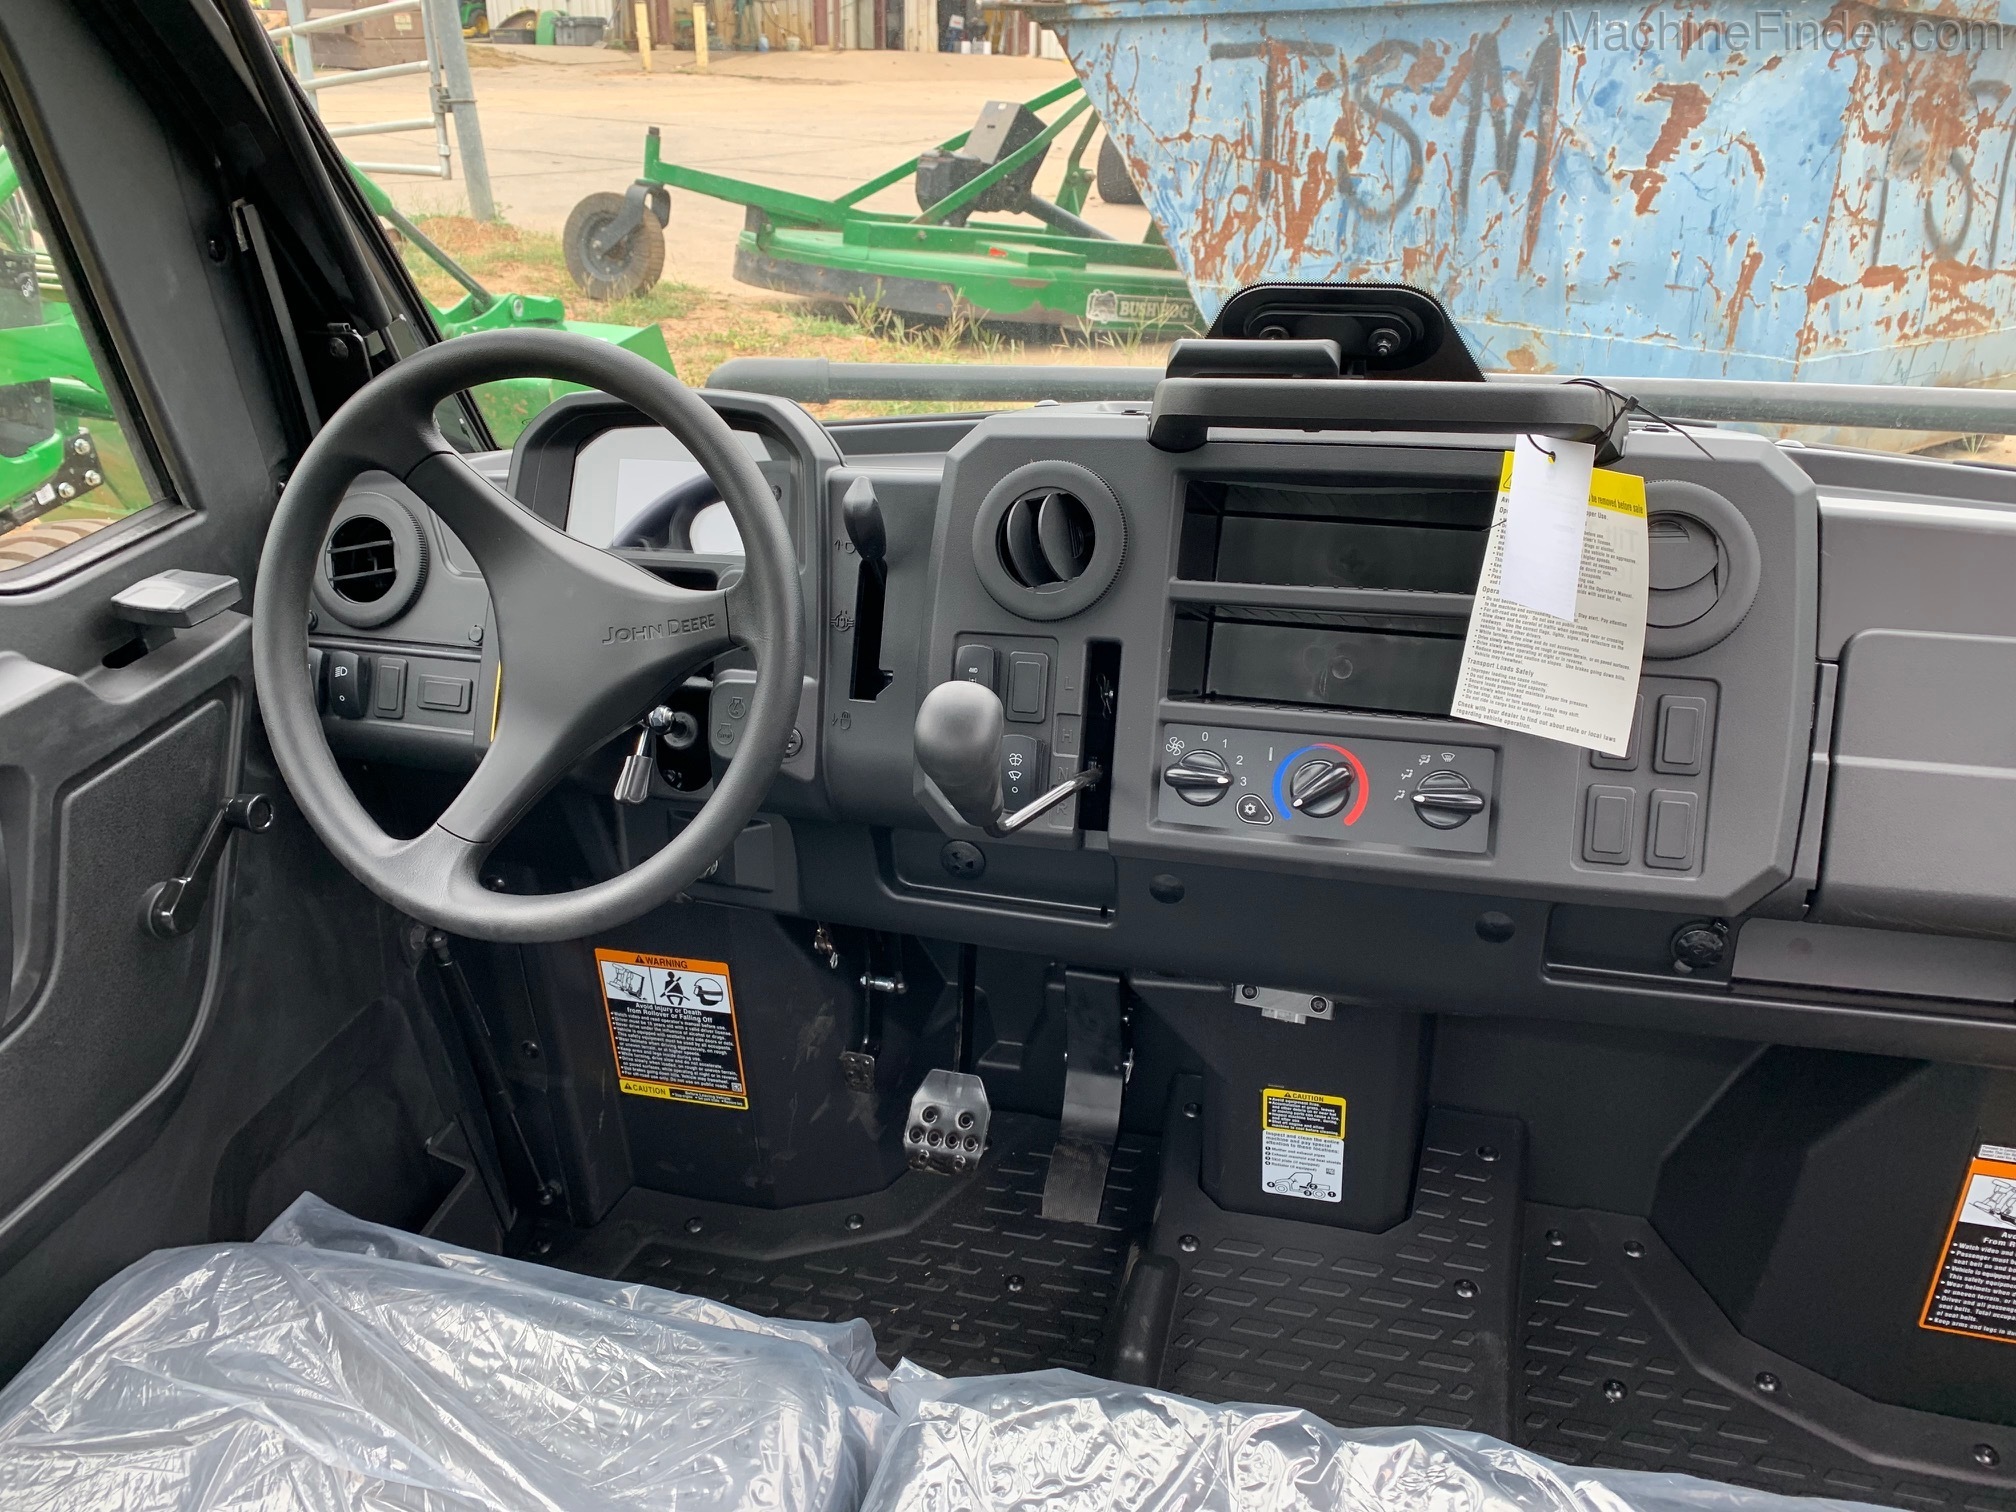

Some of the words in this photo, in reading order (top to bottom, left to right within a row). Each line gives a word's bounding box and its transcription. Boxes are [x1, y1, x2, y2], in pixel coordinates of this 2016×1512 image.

[1120, 300, 1158, 317] BUSH
[1160, 304, 1189, 318] HOG
[1597, 496, 1617, 507] removed
[1618, 501, 1632, 510] before
[1633, 504, 1644, 513] sale
[1616, 556, 1636, 565] aggressive
[602, 625, 662, 645] JOHN
[667, 614, 716, 636] DEERE
[1467, 657, 1495, 669] Transport
[1496, 663, 1514, 672] Loads
[1515, 667, 1534, 678] Safely
[1064, 676, 1074, 690] L
[1456, 707, 1482, 719] regarding
[1483, 713, 1503, 723] vehicle
[1504, 718, 1532, 730] operation.
[1458, 700, 1474, 709] Check
[1501, 710, 1519, 719] dealer
[1549, 721, 1565, 730] about
[1566, 725, 1580, 734] state
[1588, 730, 1602, 739] local
[1603, 734, 1616, 742] laws
[1061, 730, 1073, 743] H
[1202, 732, 1208, 742] 0
[1222, 738, 1228, 748] 1
[1236, 755, 1243, 765] 2
[1058, 767, 1069, 780] N
[1240, 776, 1247, 786] 3
[1056, 804, 1068, 816] R
[646, 957, 688, 968] WARNING
[643, 1009, 669, 1018] Rollover
[679, 1014, 701, 1022] Falling
[633, 1084, 666, 1095] CAUTION
[1293, 1093, 1324, 1102] CAUTION
[1983, 1237, 2006, 1246] From
[1959, 1243, 1979, 1251] Watch
[1981, 1245, 1999, 1254] video
[1956, 1251, 1990, 1261] Passenger
[1952, 1266, 1973, 1274] Vehicle
[1982, 1271, 2010, 1280] equipped
[1964, 1276, 1984, 1284] safety
[1965, 1284, 1991, 1292] helmets
